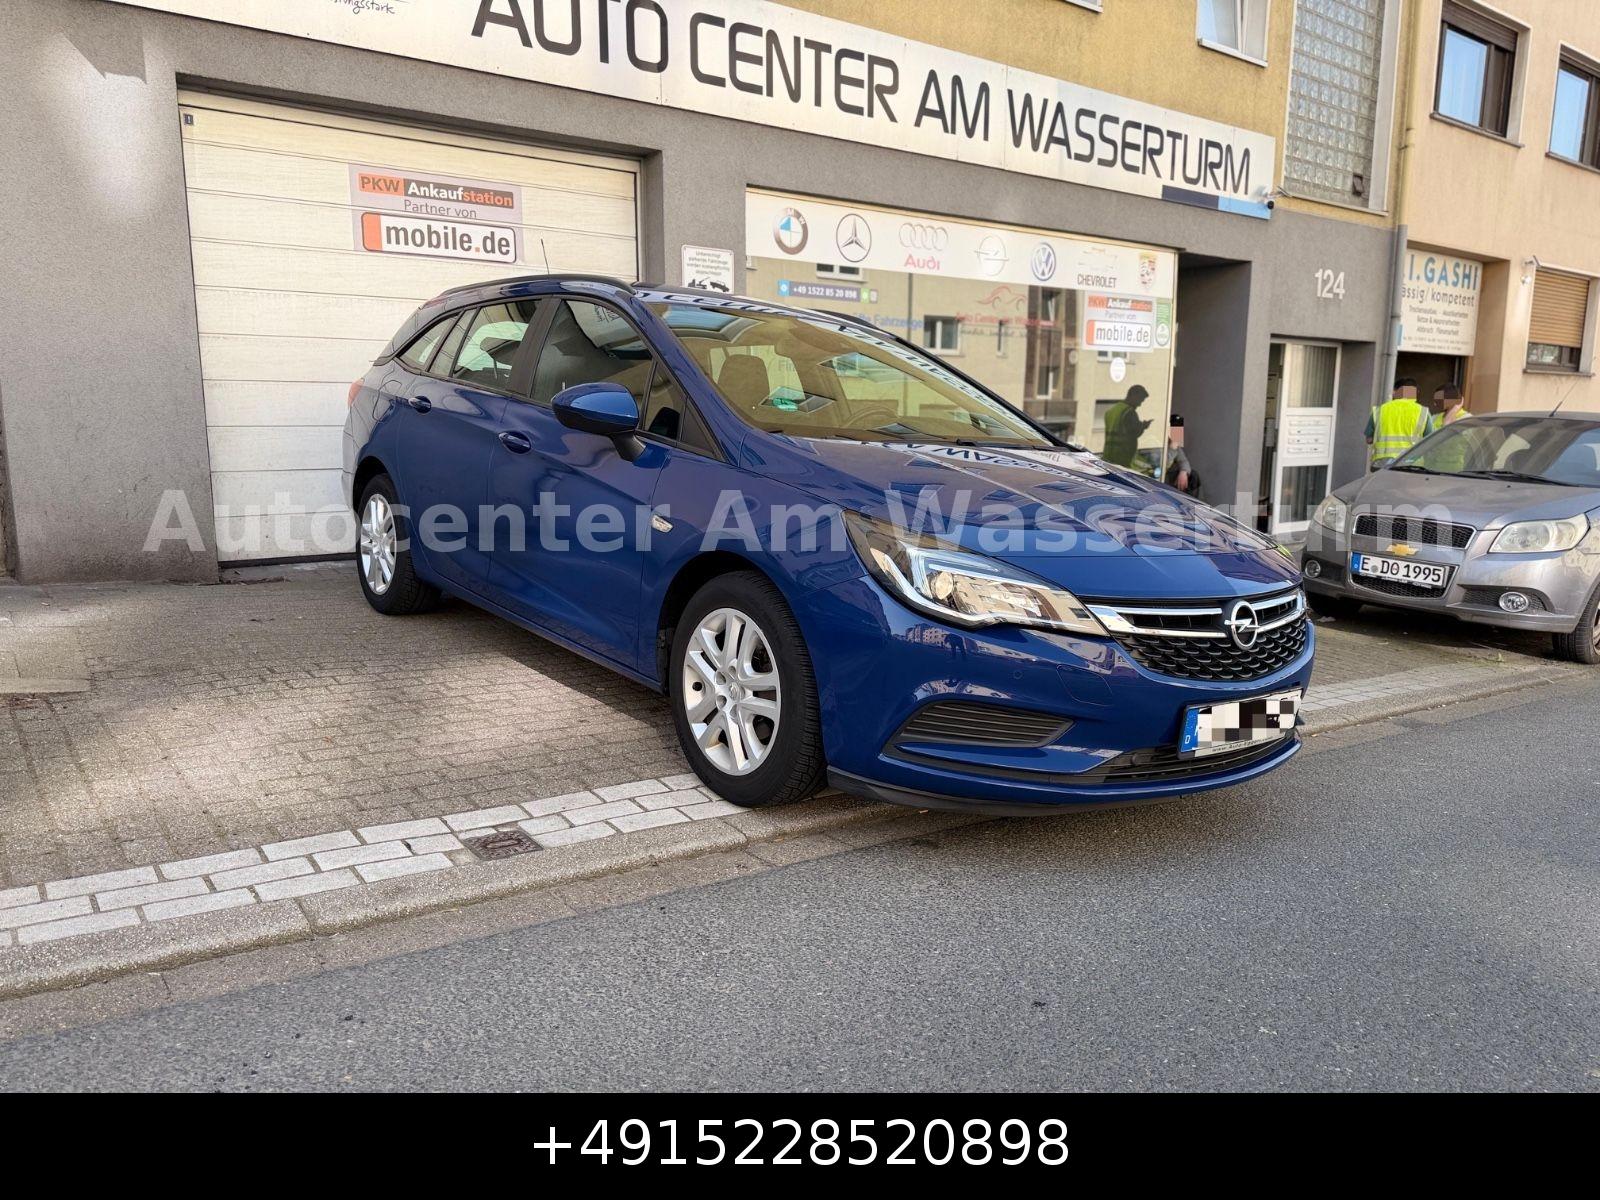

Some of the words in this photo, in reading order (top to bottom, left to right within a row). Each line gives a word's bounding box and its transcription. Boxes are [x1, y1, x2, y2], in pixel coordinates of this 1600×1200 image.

[471, 0, 669, 73] AUTO
[689, 12, 899, 122] CENTER
[915, 69, 990, 142] AM
[1008, 88, 1251, 196] WASSERTURM
[360, 175, 401, 193] PKW
[404, 200, 452, 217] Partner
[454, 207, 478, 219] von
[385, 223, 512, 257] mobile.de
[903, 253, 941, 271] Audi
[1077, 273, 1118, 289] CHEVROLET
[1314, 268, 1346, 300] 124
[807, 286, 825, 296] 1522
[1431, 288, 1475, 308] kompetent
[1104, 309, 1125, 320] Partner
[1095, 324, 1150, 343] mobile.de
[1361, 556, 1371, 572] E
[1402, 564, 1442, 583] 1995
